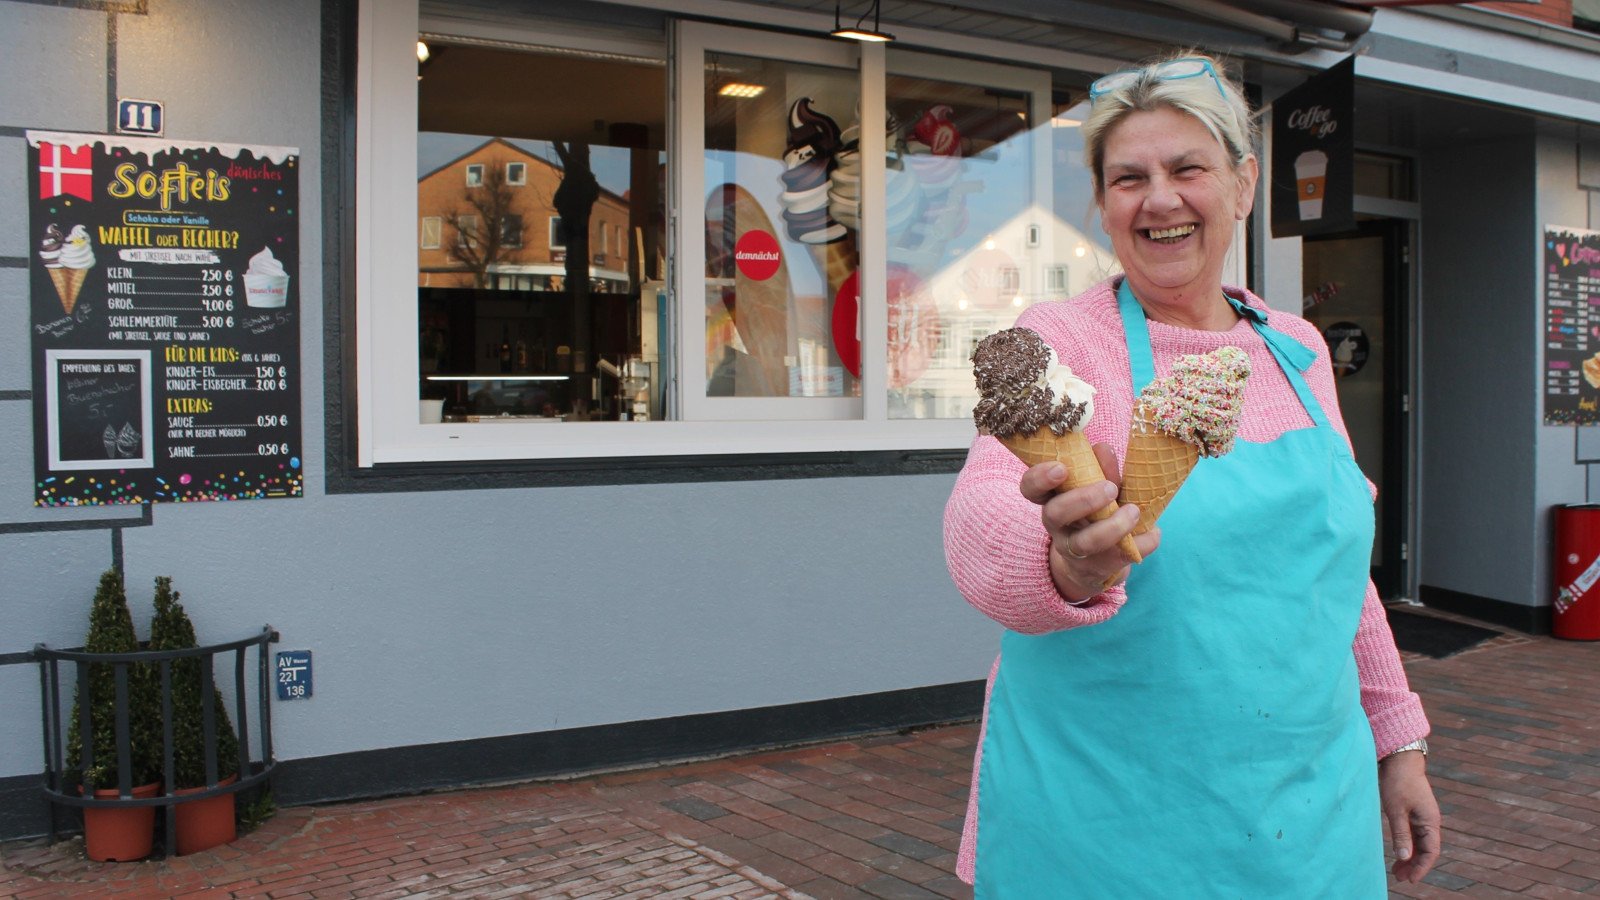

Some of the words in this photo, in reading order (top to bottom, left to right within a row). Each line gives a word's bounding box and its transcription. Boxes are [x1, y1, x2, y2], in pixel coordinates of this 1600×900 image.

[126, 104, 154, 131] 11
[1288, 105, 1331, 130] Coffee
[1318, 120, 1338, 139] go
[227, 163, 282, 180] dänisches
[107, 161, 231, 211] Softeis
[128, 213, 158, 223] Schoko
[160, 215, 181, 224] oder
[183, 216, 210, 225] Vanille
[98, 226, 153, 247] WAFFEL
[156, 234, 179, 248] ODER
[182, 229, 240, 249] BECHER?
[130, 252, 141, 260] MIT
[144, 252, 171, 261] STREUSEL
[175, 252, 192, 261] NACH
[195, 253, 212, 262] WAHL
[735, 250, 779, 261] demnächst
[107, 267, 132, 279] KLEIN
[224, 269, 234, 281] €
[107, 282, 136, 295] MITTEL
[225, 284, 234, 296] €
[225, 299, 234, 311] €
[108, 314, 178, 328] SCHLEMMERTÜTE
[226, 316, 235, 328] €
[108, 331, 122, 341] (MIT
[153, 331, 171, 341] SAUCE
[173, 331, 187, 341] UND
[188, 331, 210, 341] SAHNE)
[165, 345, 187, 363] FÜR
[189, 347, 208, 363] DIE
[210, 347, 240, 363] KIDS:
[62, 363, 102, 373] EMPFEHLUNG
[103, 363, 116, 373] DES
[166, 366, 215, 378] KINDER-EIS
[278, 366, 287, 377] €
[166, 379, 247, 391] KINDER-EISBECHER
[278, 379, 288, 391] €
[167, 397, 213, 414] EXTRAS:
[167, 416, 194, 428] SAUCE
[279, 414, 289, 426] €
[168, 429, 184, 439] (NUR
[185, 429, 194, 438] IM
[195, 429, 217, 438] BECHER
[218, 427, 247, 438] MÖGLICH)
[168, 446, 195, 458] SAHNE
[280, 443, 289, 455] €
[279, 657, 292, 667] AV
[279, 672, 292, 683] 22
[286, 685, 305, 696] 136
